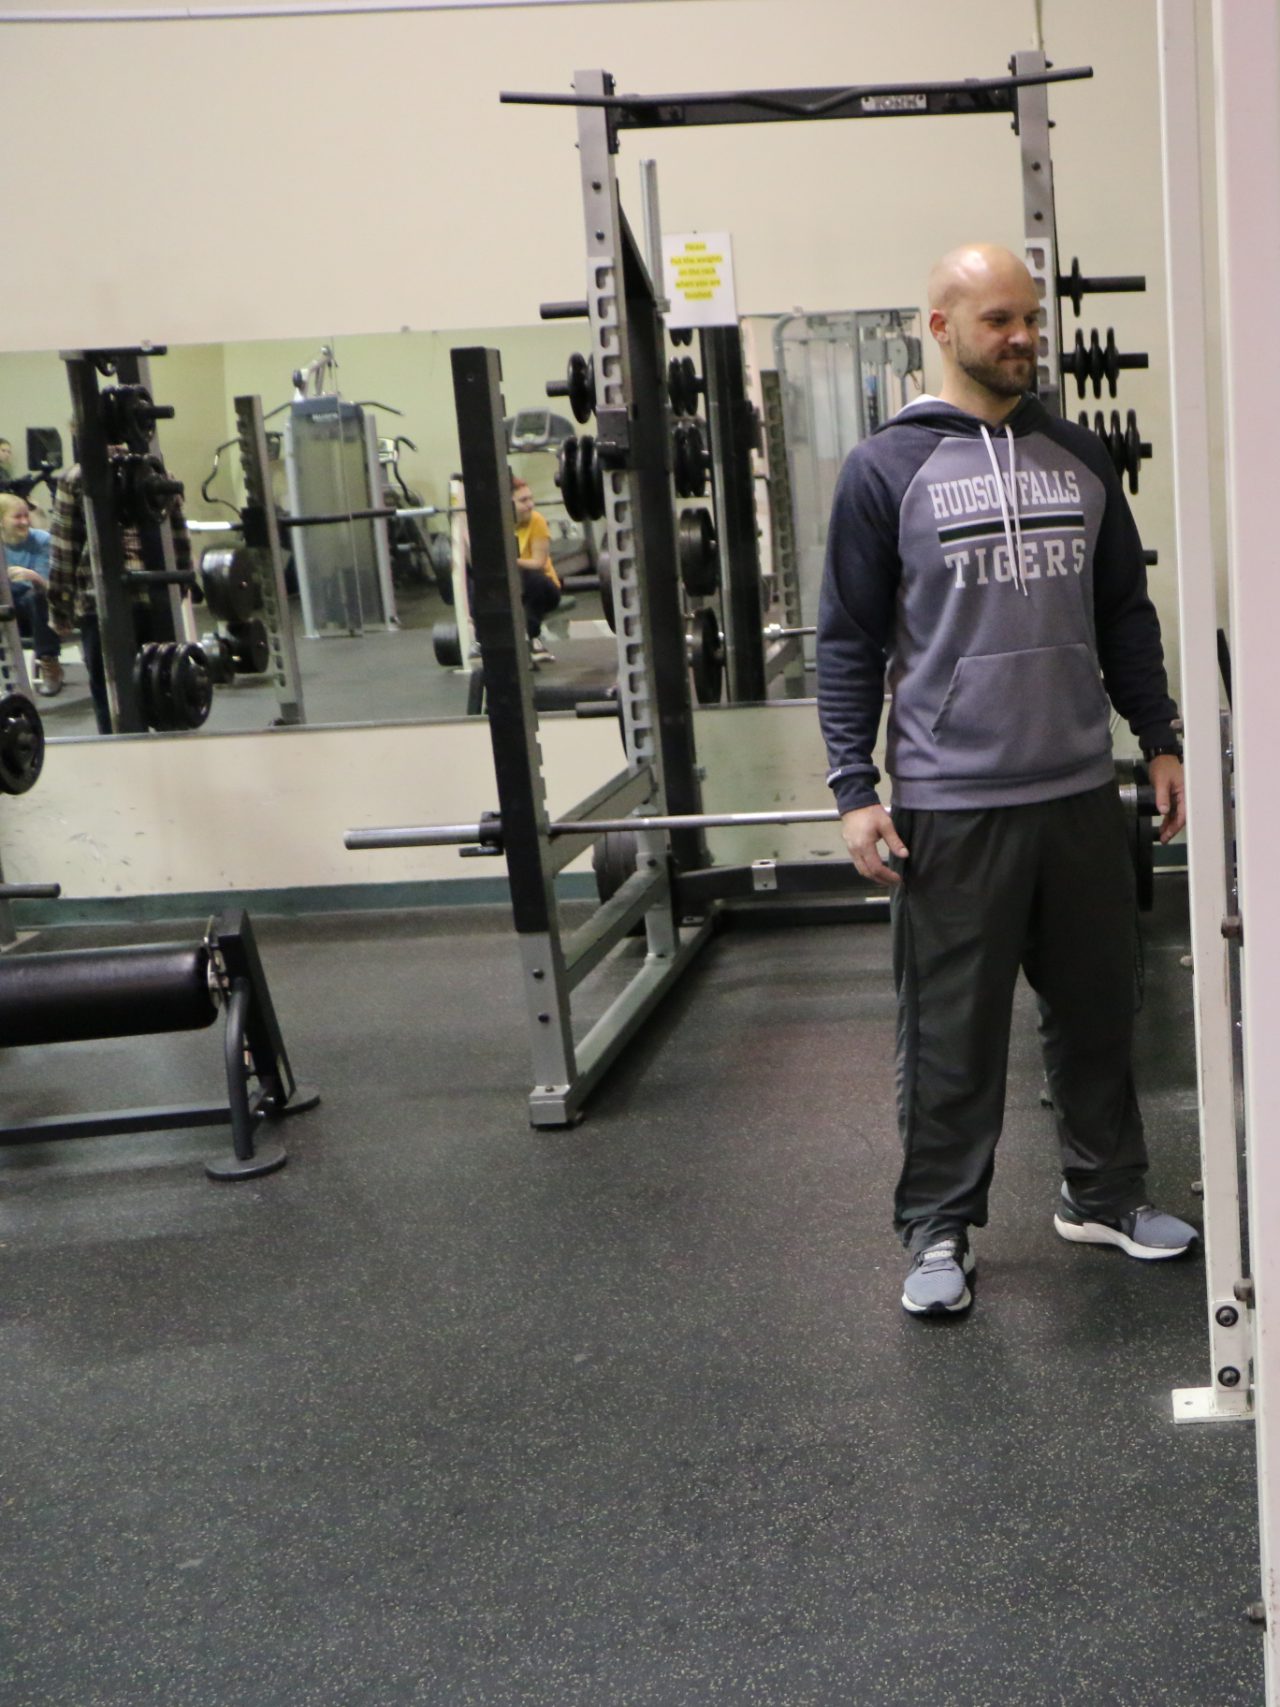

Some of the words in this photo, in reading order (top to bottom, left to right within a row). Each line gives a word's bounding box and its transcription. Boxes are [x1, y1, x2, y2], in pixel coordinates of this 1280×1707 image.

[927, 472, 1016, 519] HUDSON
[1015, 470, 1081, 507] FALLS
[944, 538, 1086, 589] TIGERS
